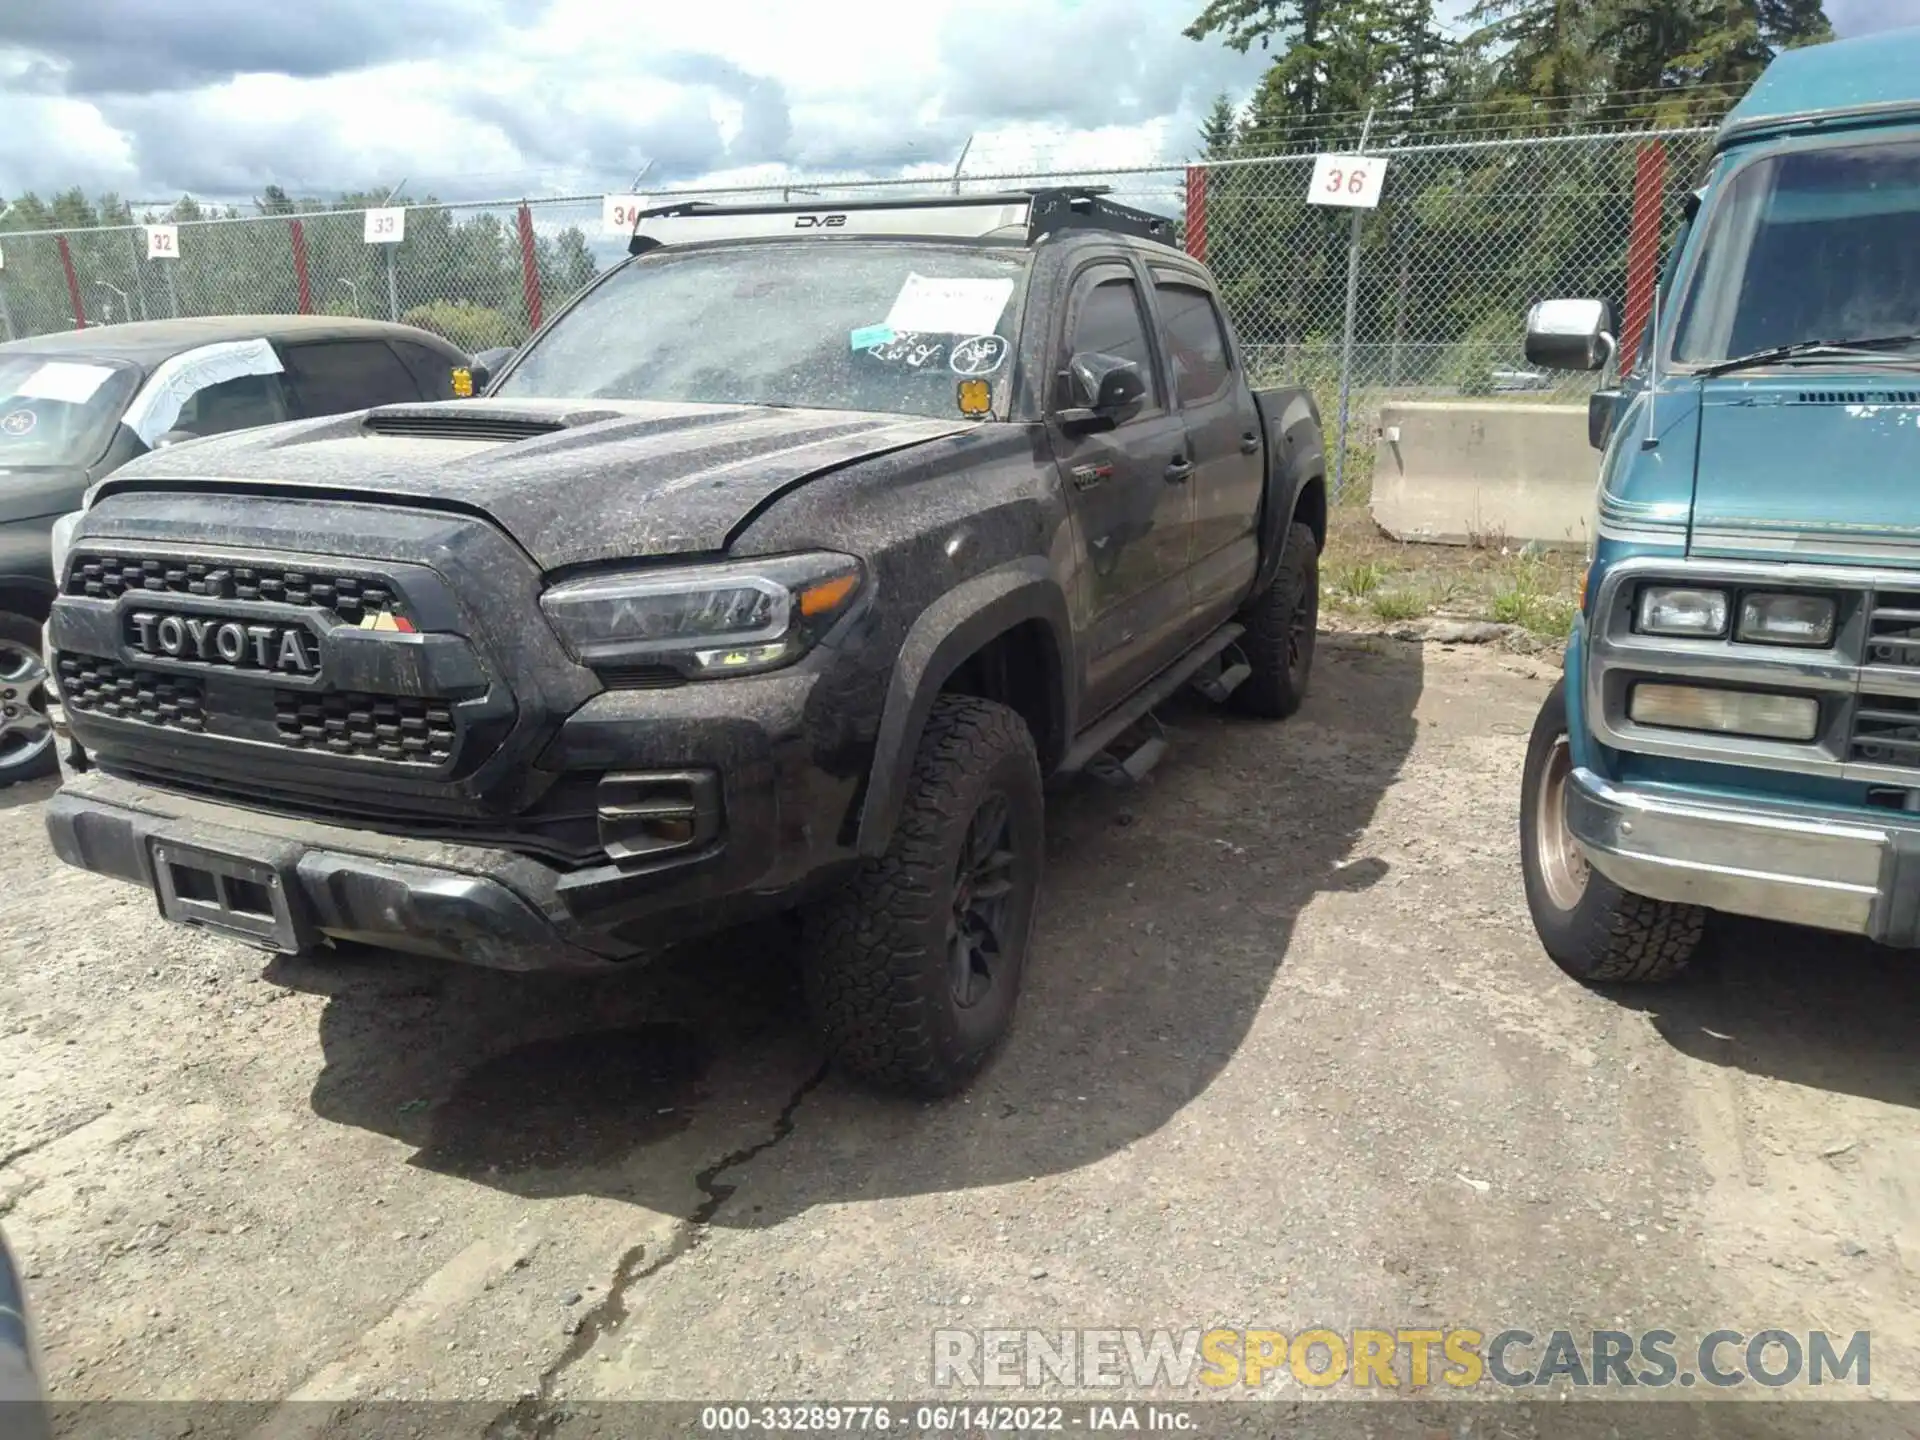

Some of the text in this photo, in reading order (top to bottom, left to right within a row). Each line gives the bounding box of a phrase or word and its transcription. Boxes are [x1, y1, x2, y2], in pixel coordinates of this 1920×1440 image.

[1326, 169, 1366, 194] 36
[374, 217, 394, 234] 33
[614, 205, 636, 226] 34
[154, 234, 172, 250] 32
[132, 612, 312, 671] TOYOTA
